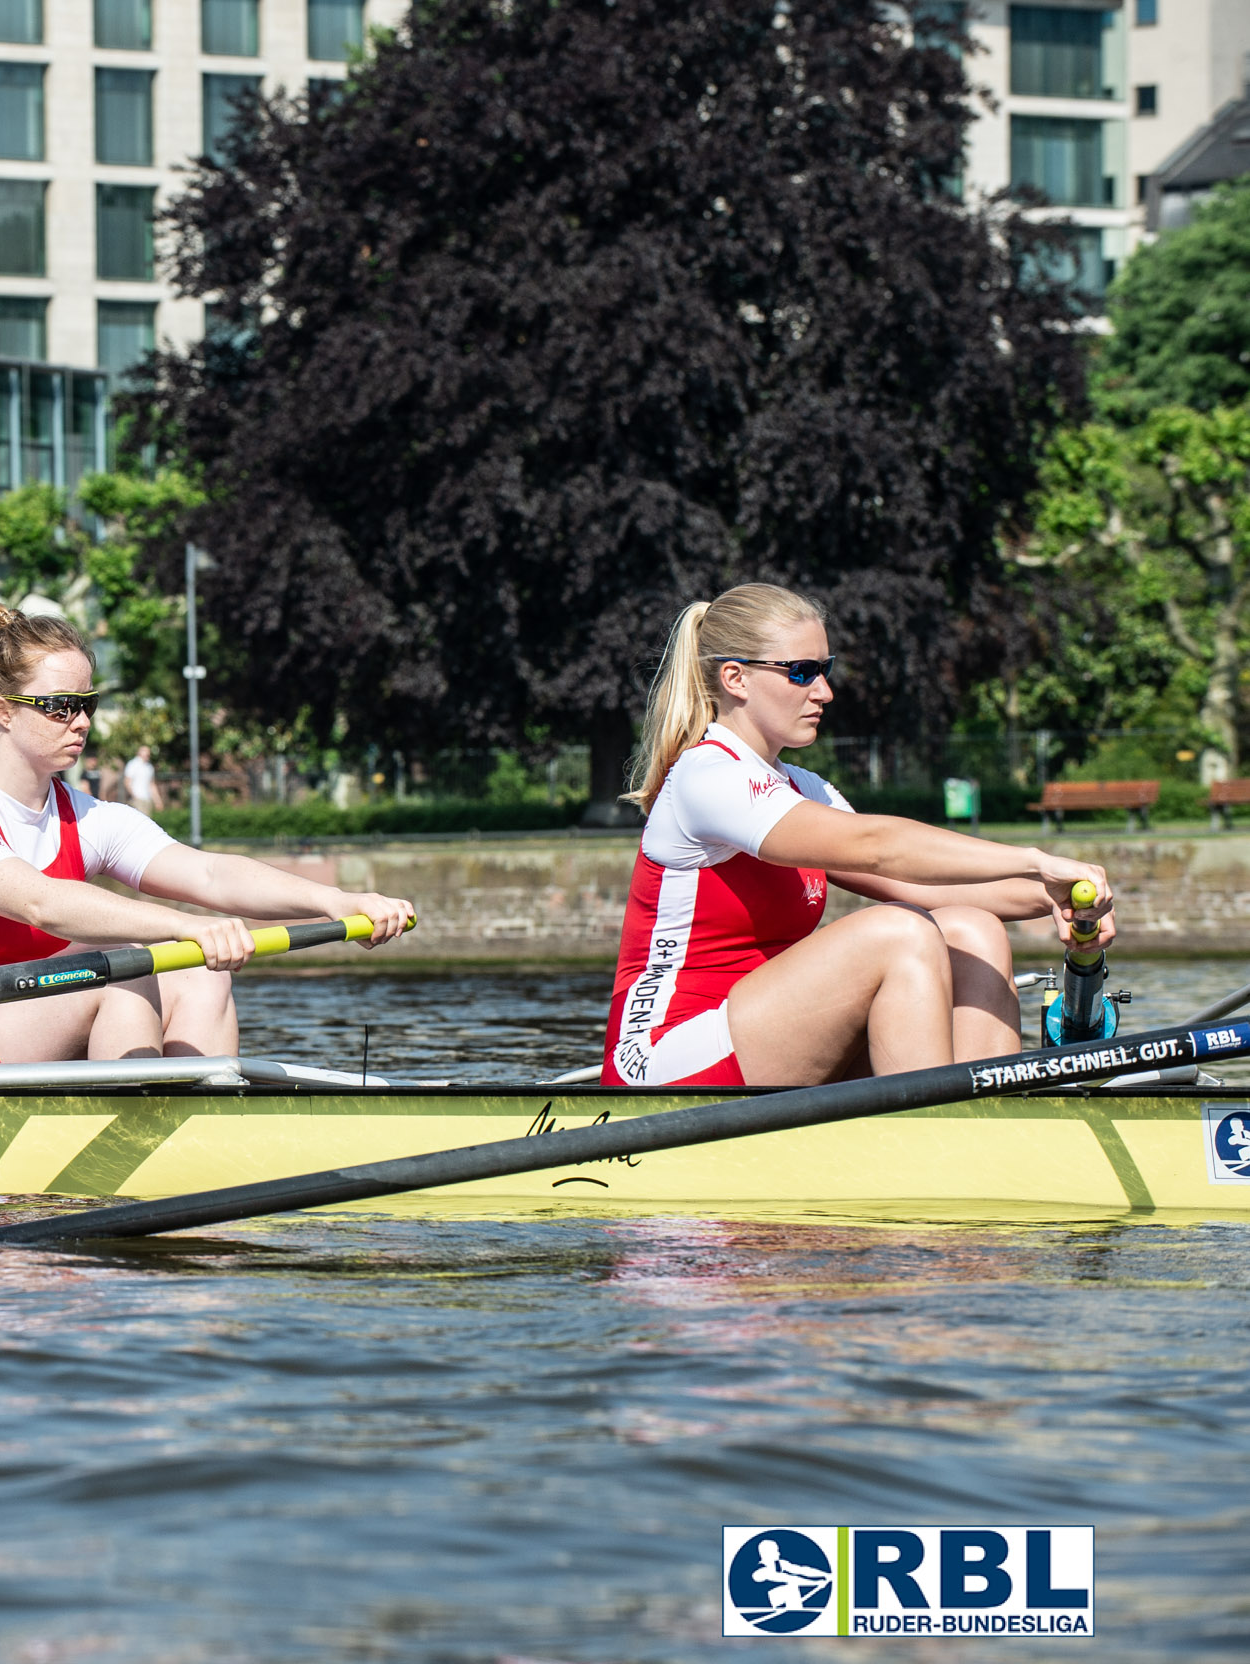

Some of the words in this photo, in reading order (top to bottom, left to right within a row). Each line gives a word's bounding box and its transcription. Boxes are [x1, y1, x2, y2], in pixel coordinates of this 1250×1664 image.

[655, 938, 677, 959] 8+
[1205, 1029, 1242, 1047] RBL
[981, 1060, 1047, 1087] STARK.
[1046, 1048, 1138, 1077] SCHNELL.
[1139, 1039, 1183, 1061] GUT.
